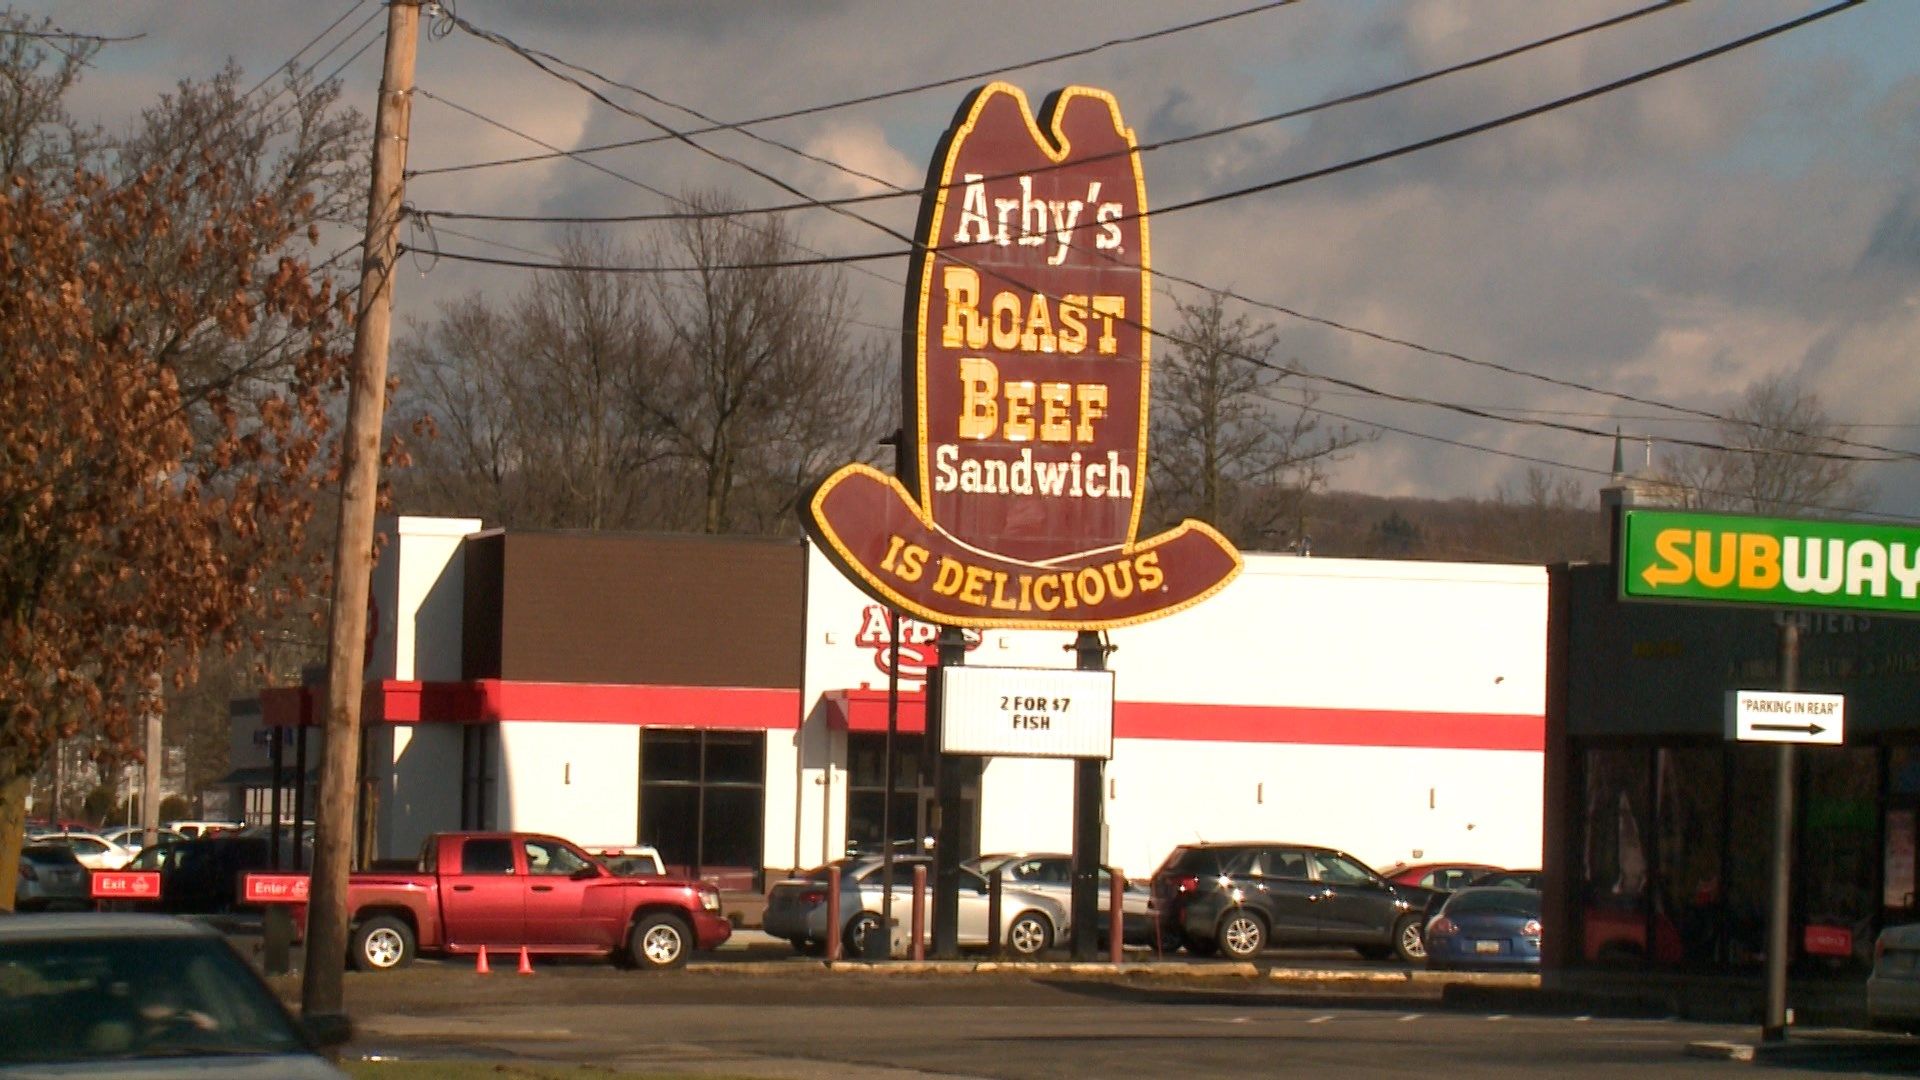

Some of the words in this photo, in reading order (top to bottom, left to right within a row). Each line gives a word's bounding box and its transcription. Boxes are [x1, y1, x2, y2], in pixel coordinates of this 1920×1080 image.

[954, 173, 1124, 266] Arby's
[942, 266, 1126, 355] ROAST
[958, 357, 1109, 443] BEEF
[935, 444, 1133, 498] Sandwich
[880, 535, 930, 582] IS
[932, 551, 1165, 612] DELICIOUS
[1641, 528, 1920, 599] SUBWAY
[1000, 696, 1009, 711] 2
[1014, 696, 1048, 712] FOR
[1052, 698, 1071, 713] $7
[1013, 714, 1050, 730] FISH
[1794, 702, 1805, 714] IN
[102, 878, 127, 890] Exit
[255, 881, 288, 894] Enter
